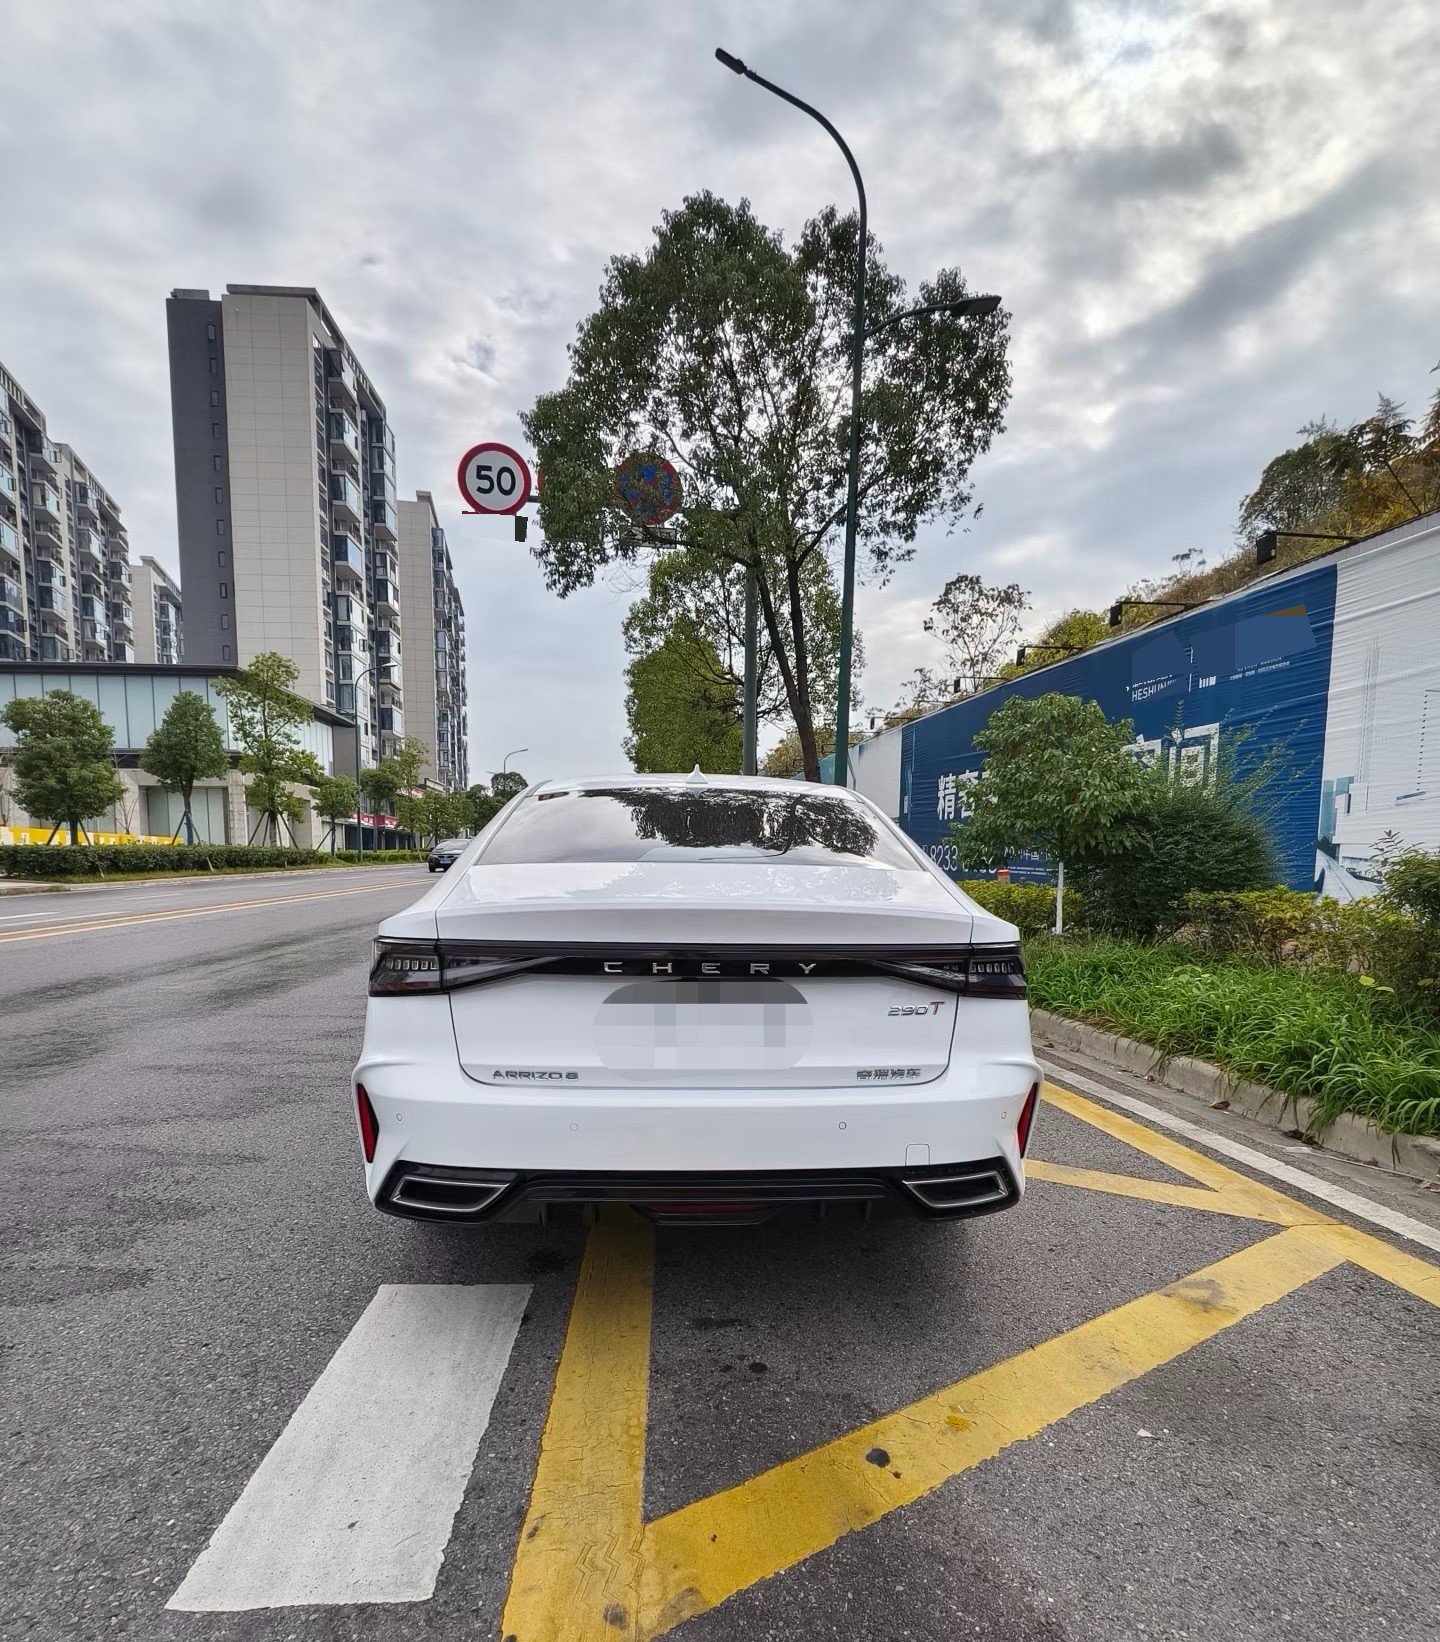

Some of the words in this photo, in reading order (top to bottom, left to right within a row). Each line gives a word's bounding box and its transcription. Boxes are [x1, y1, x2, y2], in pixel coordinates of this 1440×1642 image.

[476, 465, 516, 496] 50
[603, 961, 817, 974] CHERY
[887, 1001, 945, 1017] 290T
[492, 1070, 563, 1080] ARRIZO
